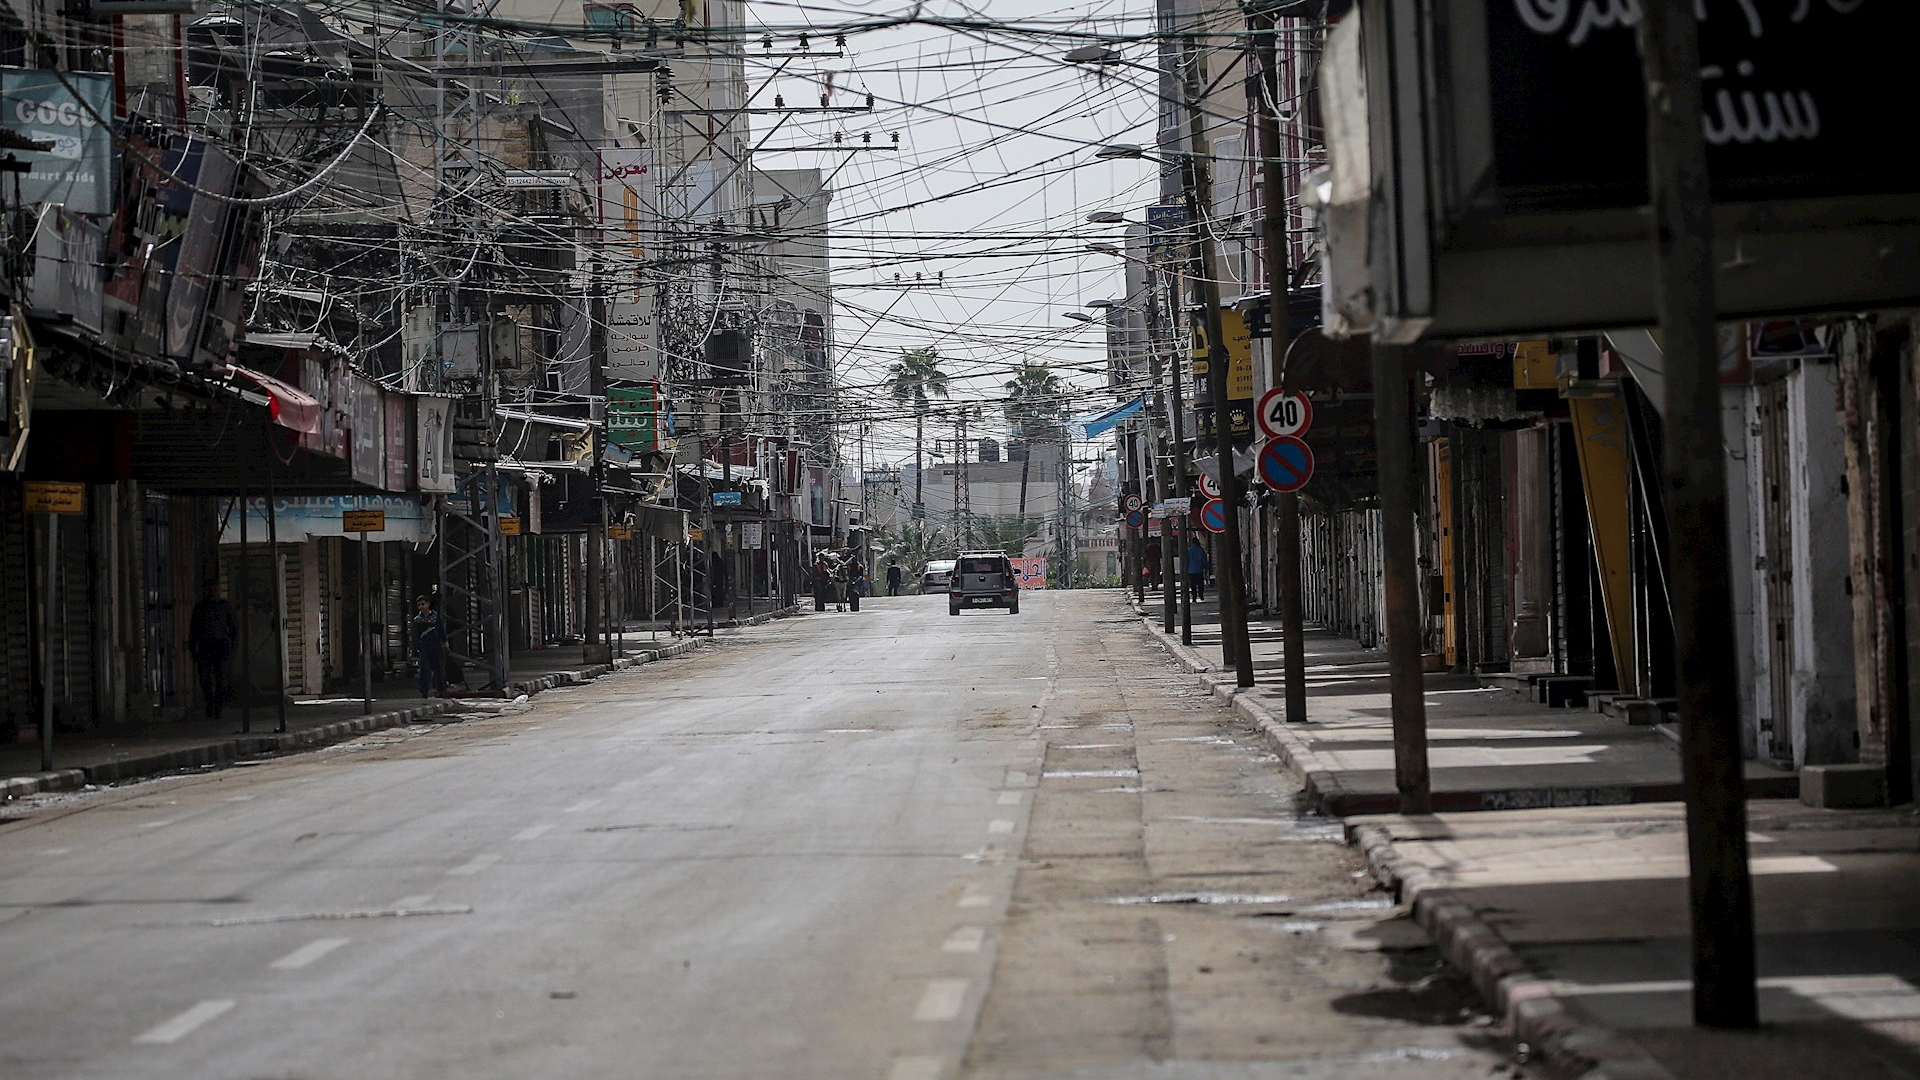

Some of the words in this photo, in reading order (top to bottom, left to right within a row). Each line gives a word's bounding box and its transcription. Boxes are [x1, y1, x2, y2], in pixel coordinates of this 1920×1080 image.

[65, 171, 95, 182] Kids
[1270, 400, 1298, 428] 40
[1128, 498, 1139, 508] 40
